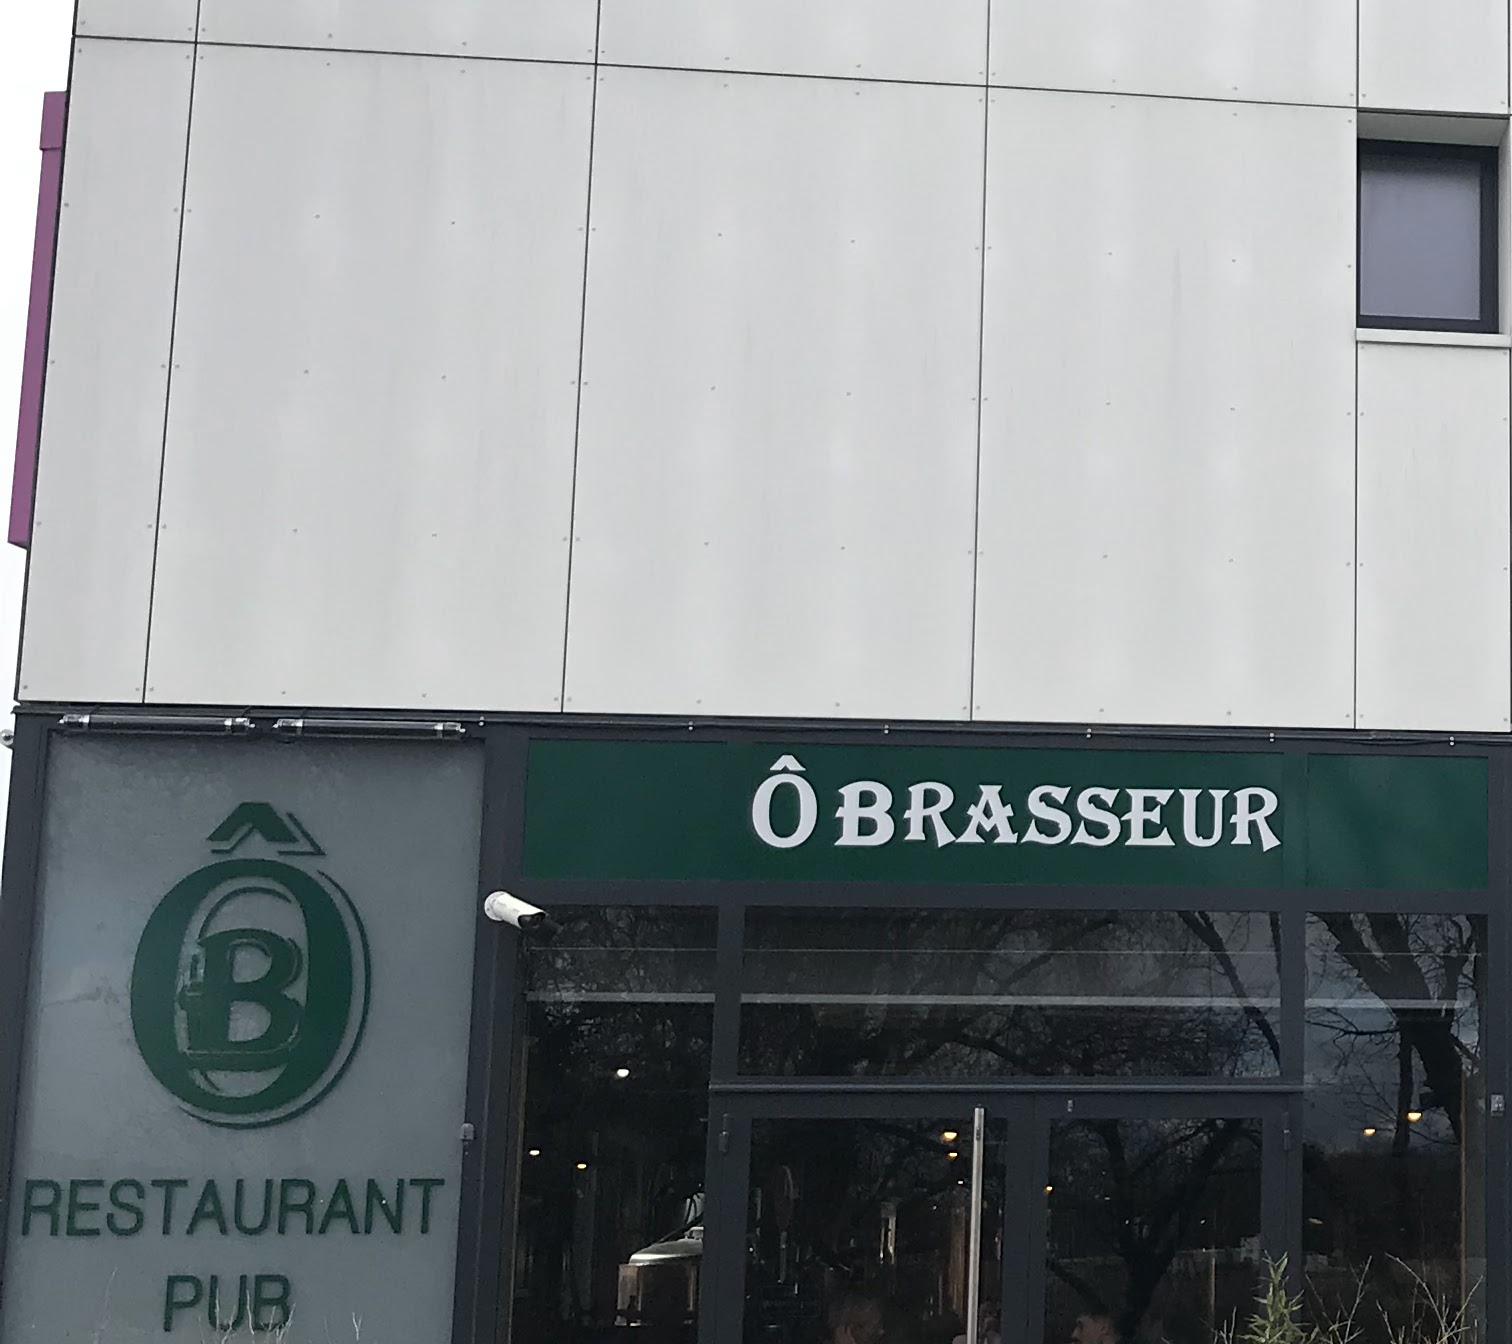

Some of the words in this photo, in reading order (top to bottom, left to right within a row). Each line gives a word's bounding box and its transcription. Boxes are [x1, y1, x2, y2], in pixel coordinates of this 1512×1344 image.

[752, 755, 817, 848] Ô
[834, 780, 1281, 852] BRASSEUR
[22, 1178, 446, 1236] RESTAURANT
[163, 1274, 293, 1332] PUB
